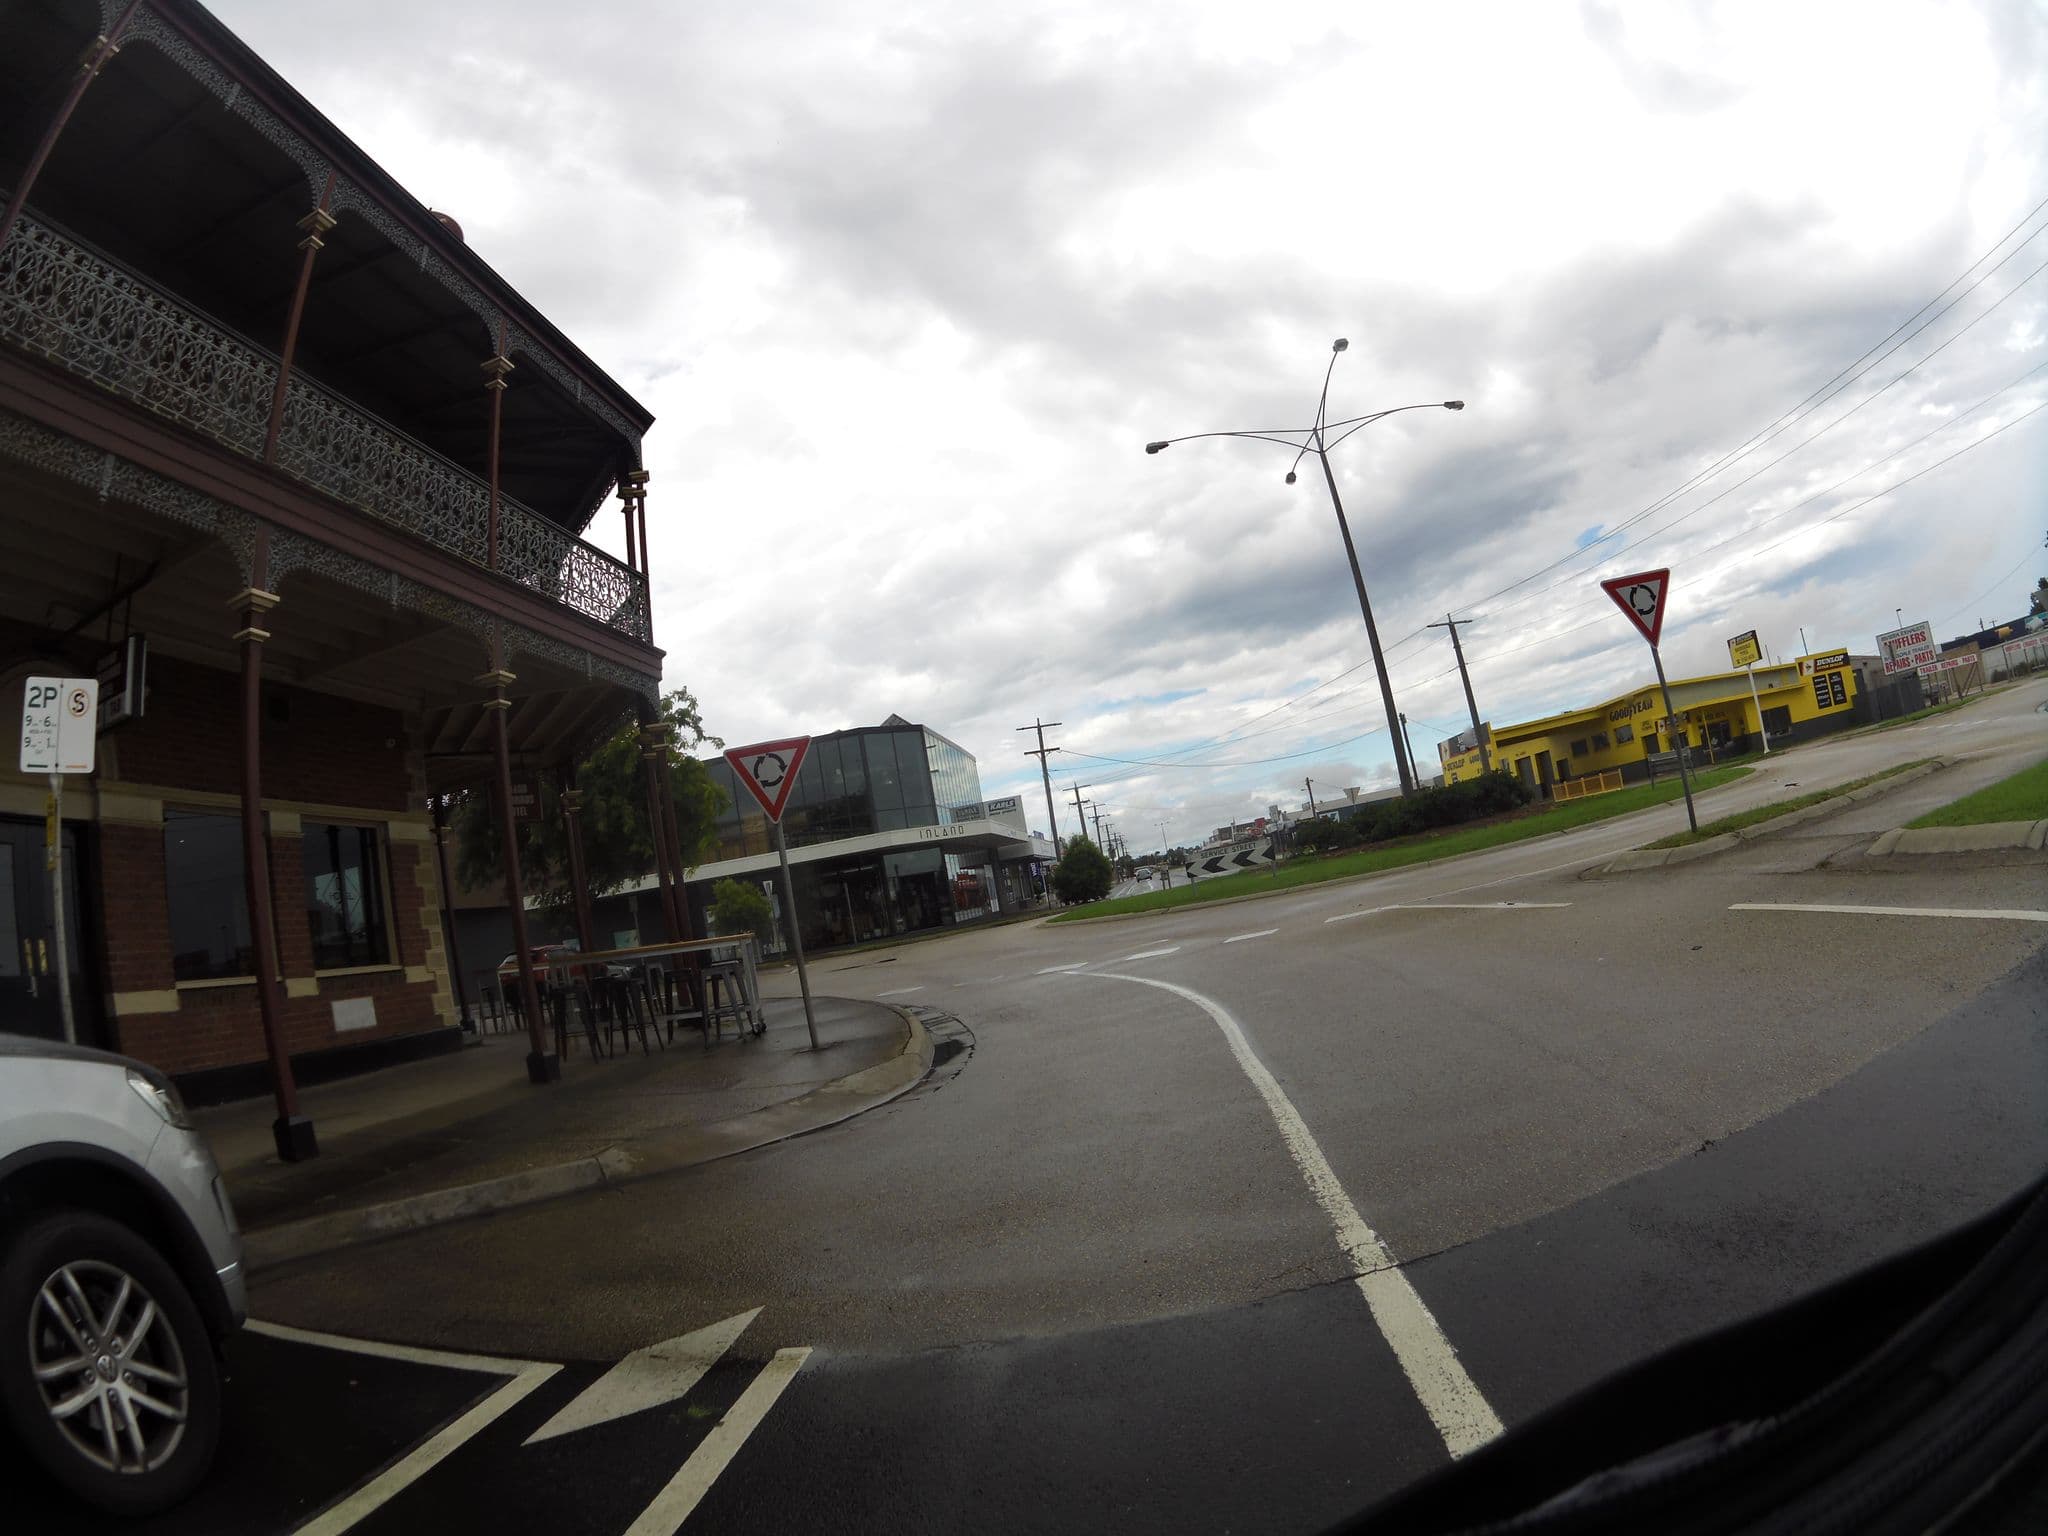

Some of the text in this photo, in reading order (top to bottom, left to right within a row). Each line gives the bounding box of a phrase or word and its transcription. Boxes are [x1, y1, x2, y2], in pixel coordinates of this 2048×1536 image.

[1914, 650, 1934, 665] PARTS
[28, 686, 58, 708] 2P
[919, 825, 965, 840] INLAND
[1200, 842, 1256, 860] SERVICE STREET
